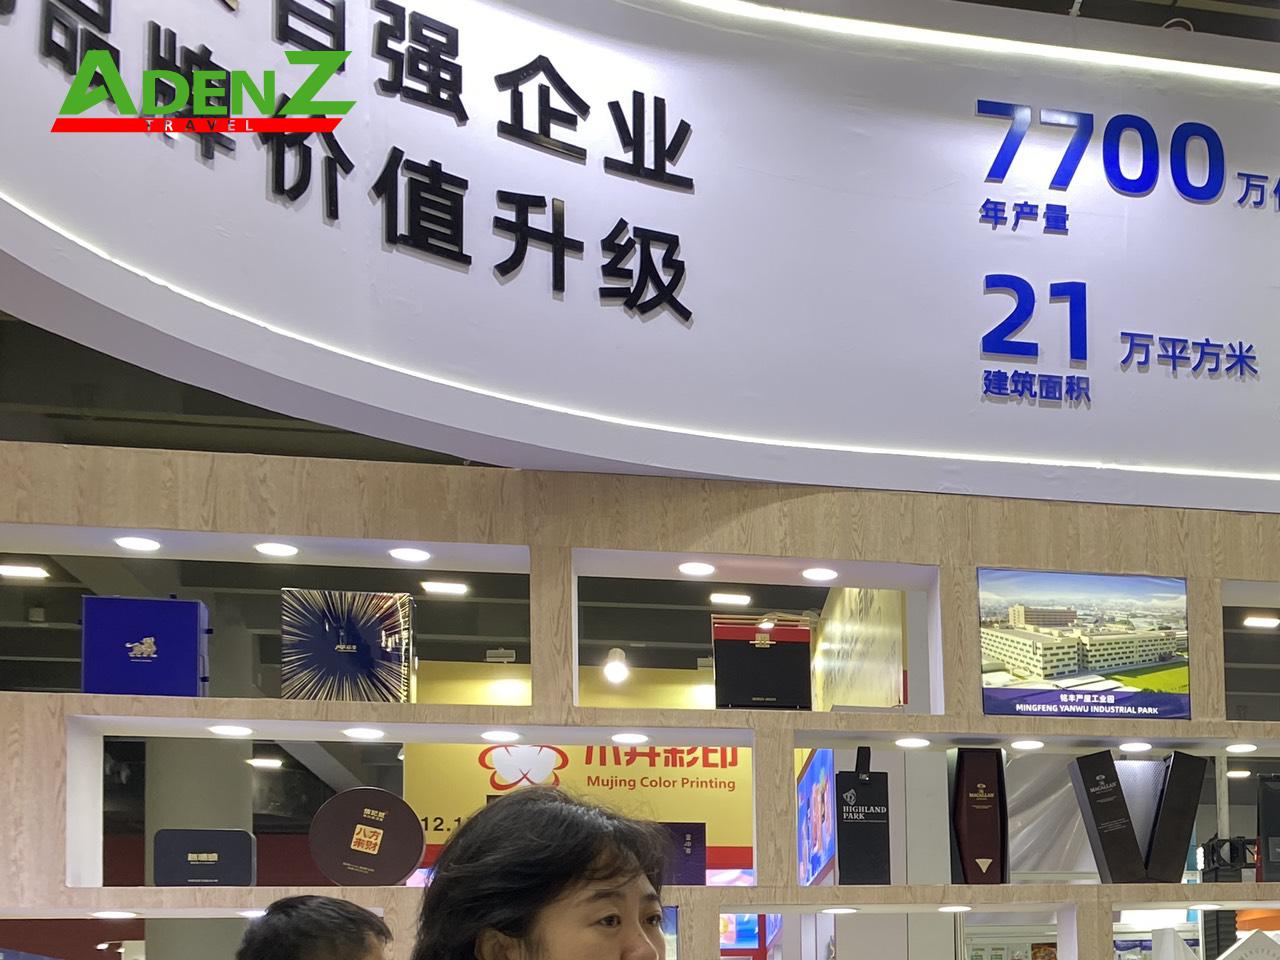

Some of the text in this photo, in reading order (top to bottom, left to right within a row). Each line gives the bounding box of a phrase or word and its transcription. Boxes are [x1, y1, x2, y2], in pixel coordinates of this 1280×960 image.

[976, 99, 1226, 203] 7700
[979, 198, 1069, 235] 年产量
[981, 273, 1260, 377] 21 万平方米
[981, 368, 1092, 404] 建筑面积
[1015, 703, 1159, 714] MINGFENG YANWU INDUSTRIAL PARK
[587, 776, 736, 792] Mujing Color Printing
[843, 805, 887, 813] HIGHLAND
[843, 812, 865, 820] PARK
[421, 816, 470, 832] 12.1
